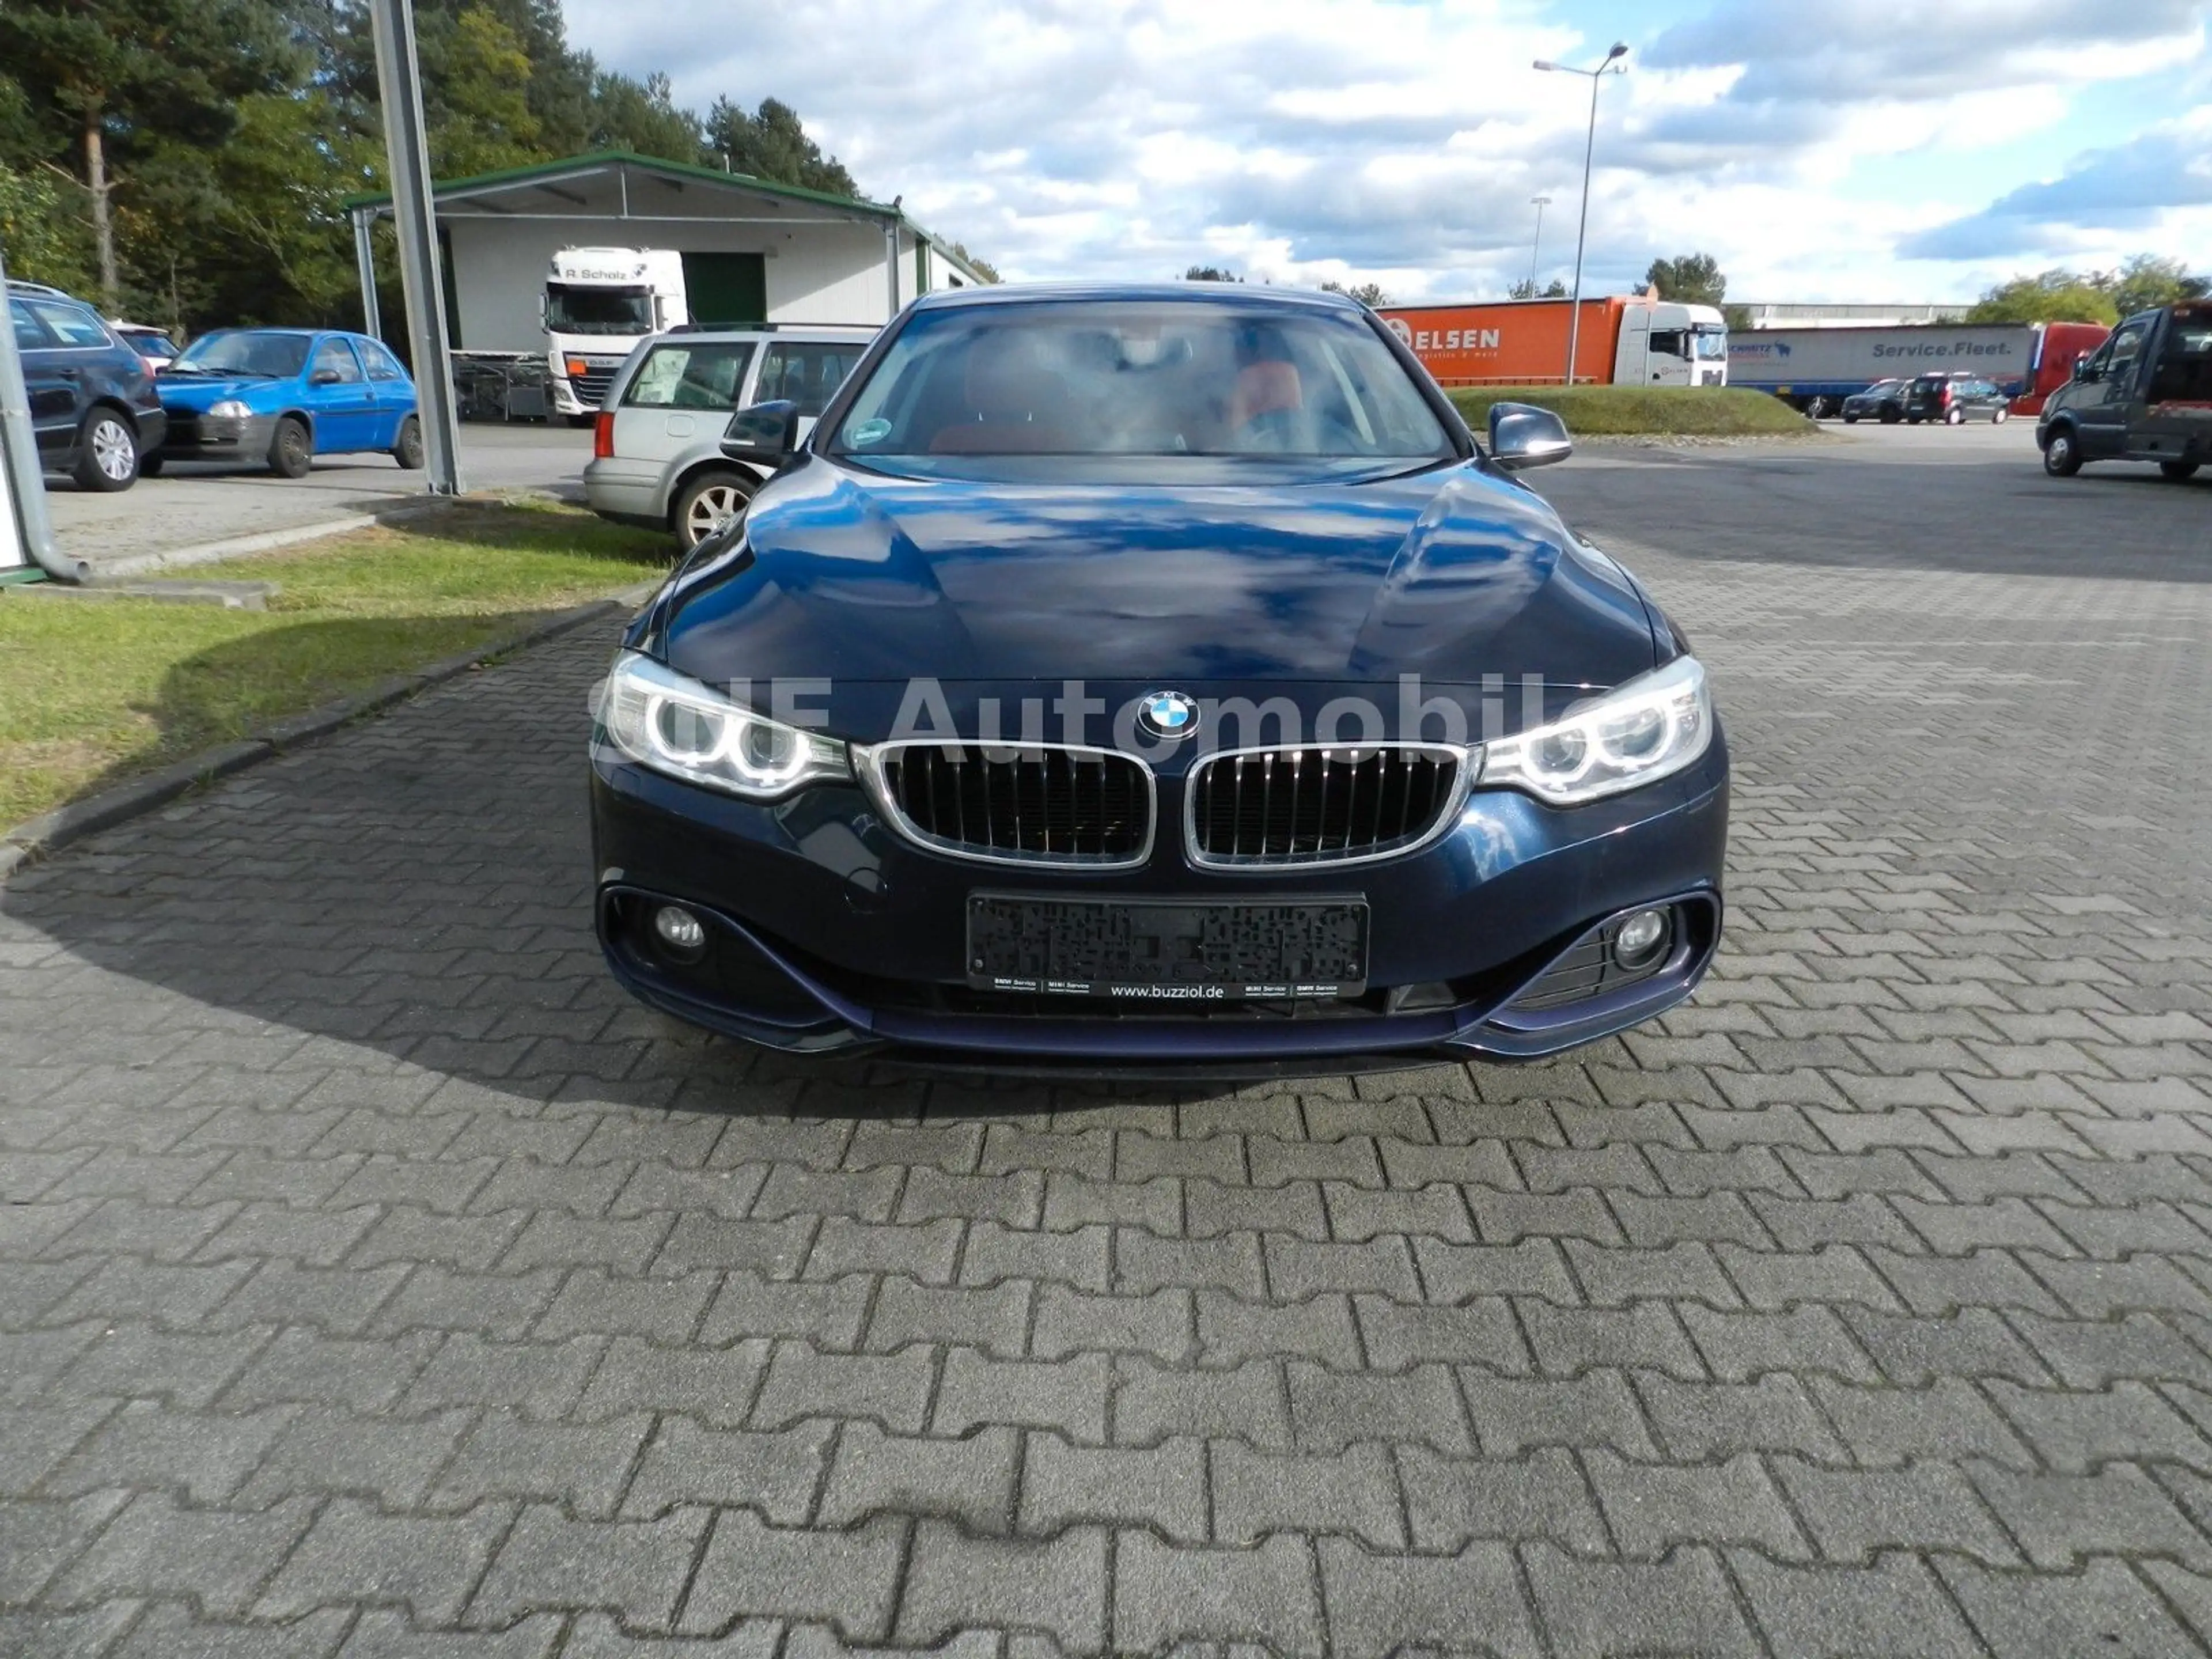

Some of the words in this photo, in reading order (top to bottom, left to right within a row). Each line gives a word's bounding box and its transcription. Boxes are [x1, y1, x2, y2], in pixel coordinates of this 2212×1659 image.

[581, 269, 627, 281] Scholz
[1415, 328, 1499, 350] ELSEN
[1872, 342, 2012, 357] Service.Fleet.
[1111, 984, 1224, 998] www.buzziol.de
